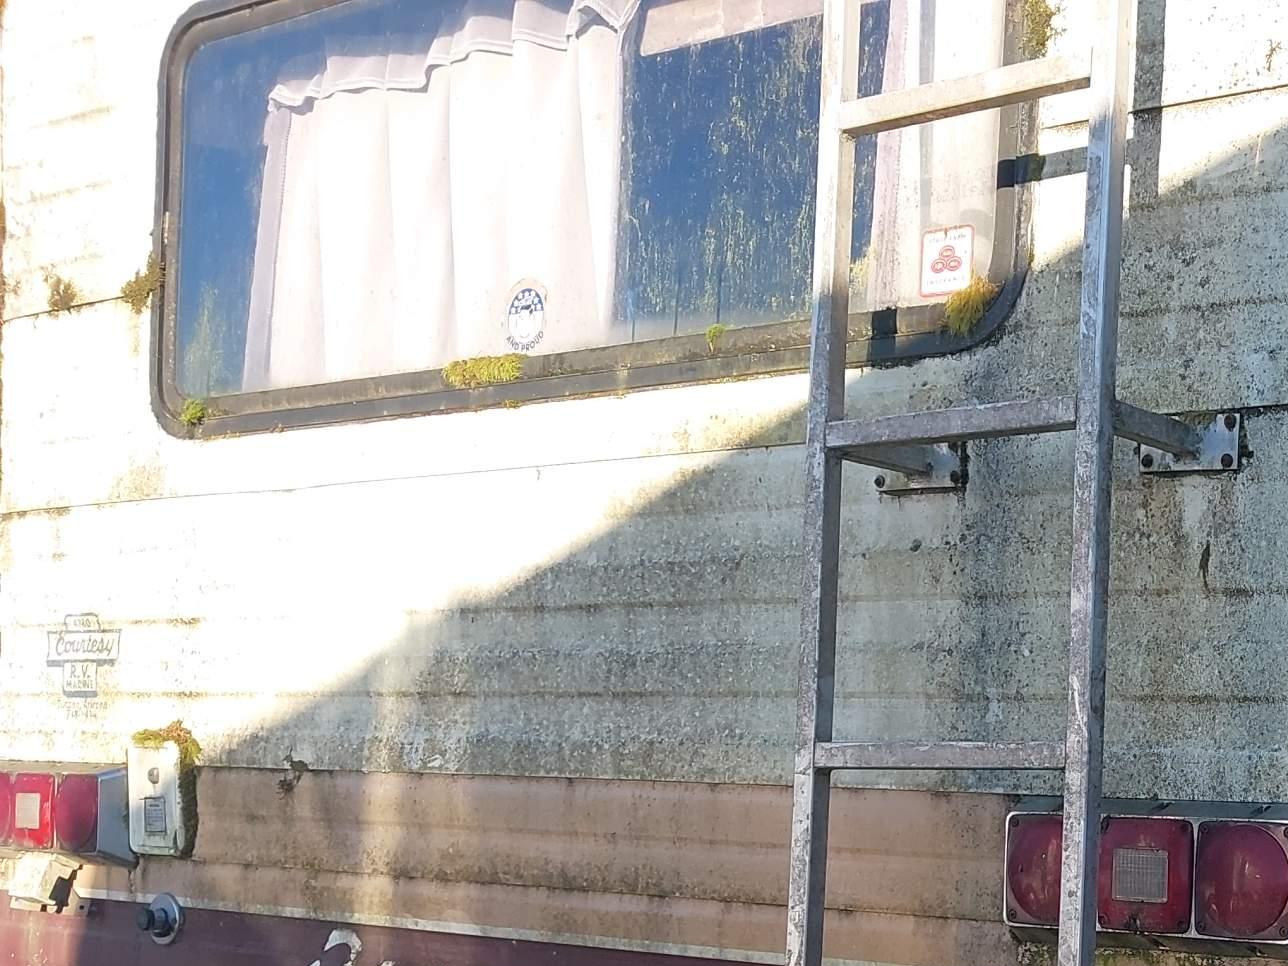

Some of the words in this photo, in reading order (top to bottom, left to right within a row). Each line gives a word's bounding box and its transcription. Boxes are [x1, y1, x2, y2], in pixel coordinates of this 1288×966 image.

[506, 336, 519, 351] AND
[521, 330, 544, 352] PROUD
[56, 630, 114, 657] Courtesy
